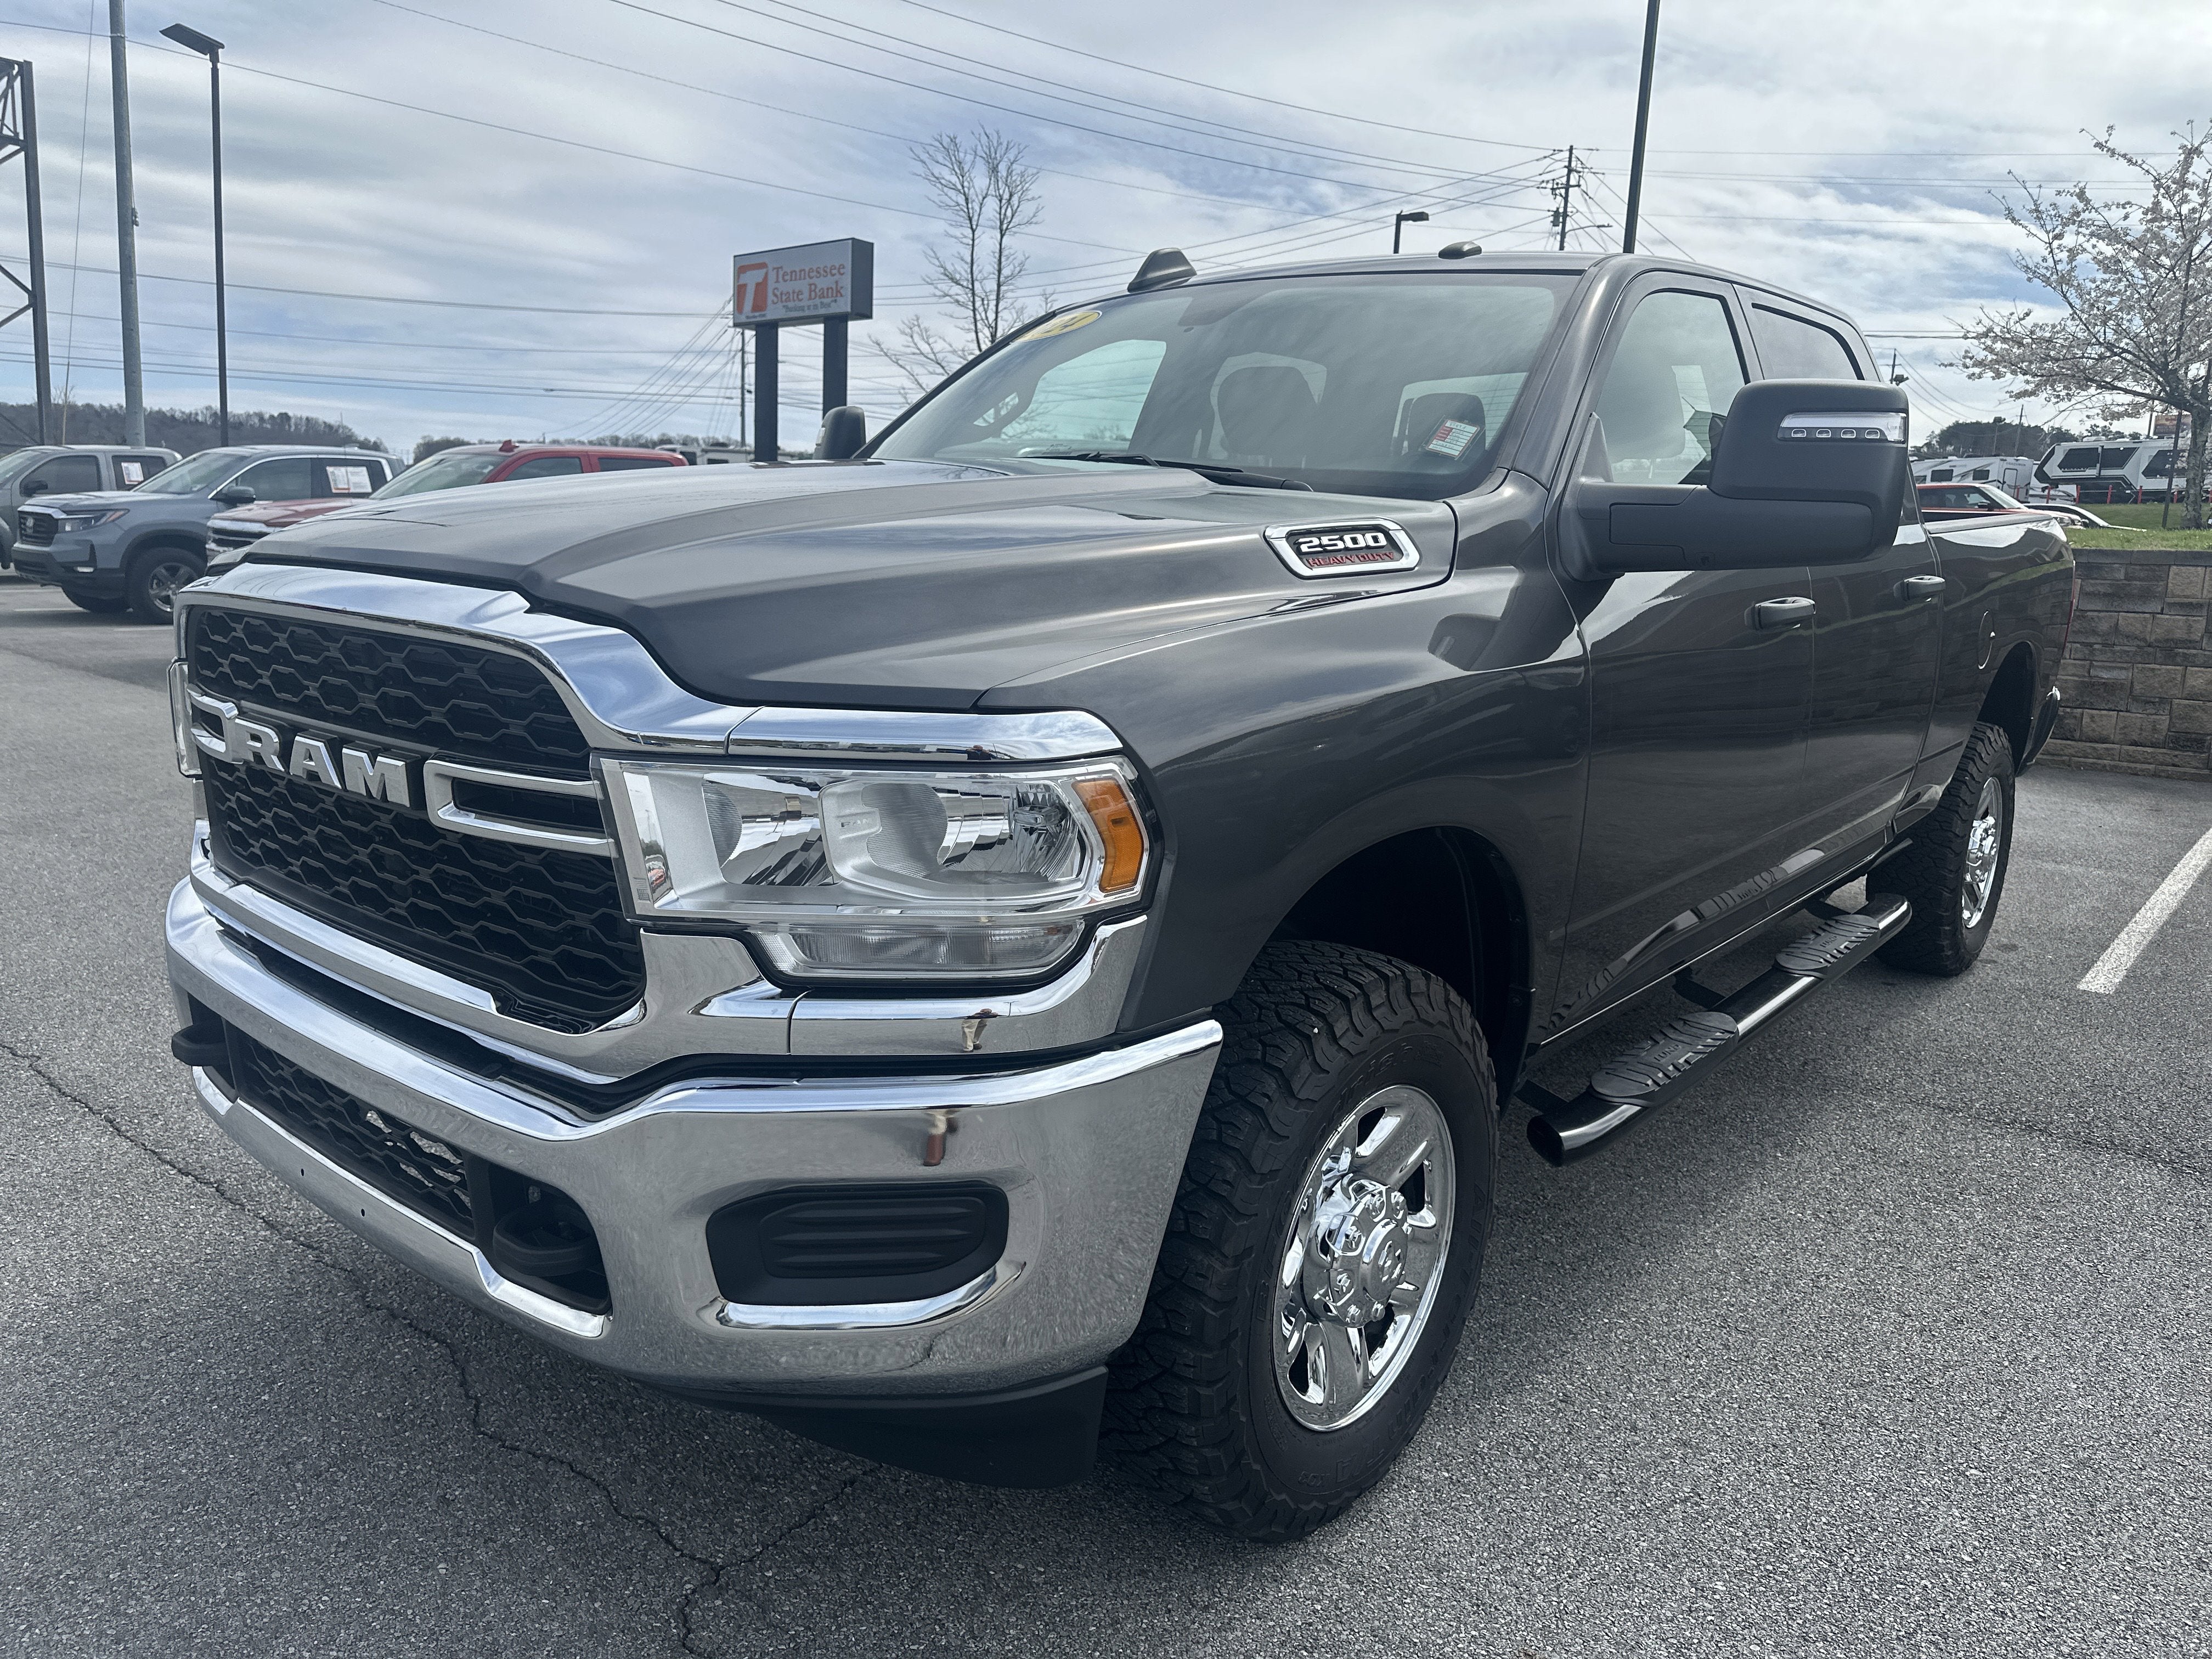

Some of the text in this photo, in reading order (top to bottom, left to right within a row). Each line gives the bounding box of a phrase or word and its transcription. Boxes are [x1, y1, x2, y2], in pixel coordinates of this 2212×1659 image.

[771, 263, 845, 283] Tennessee
[771, 280, 843, 304] State Bank
[1297, 532, 1387, 552] 2500
[1307, 552, 1395, 567] HEAVY DUTY
[234, 716, 413, 808] RAM
